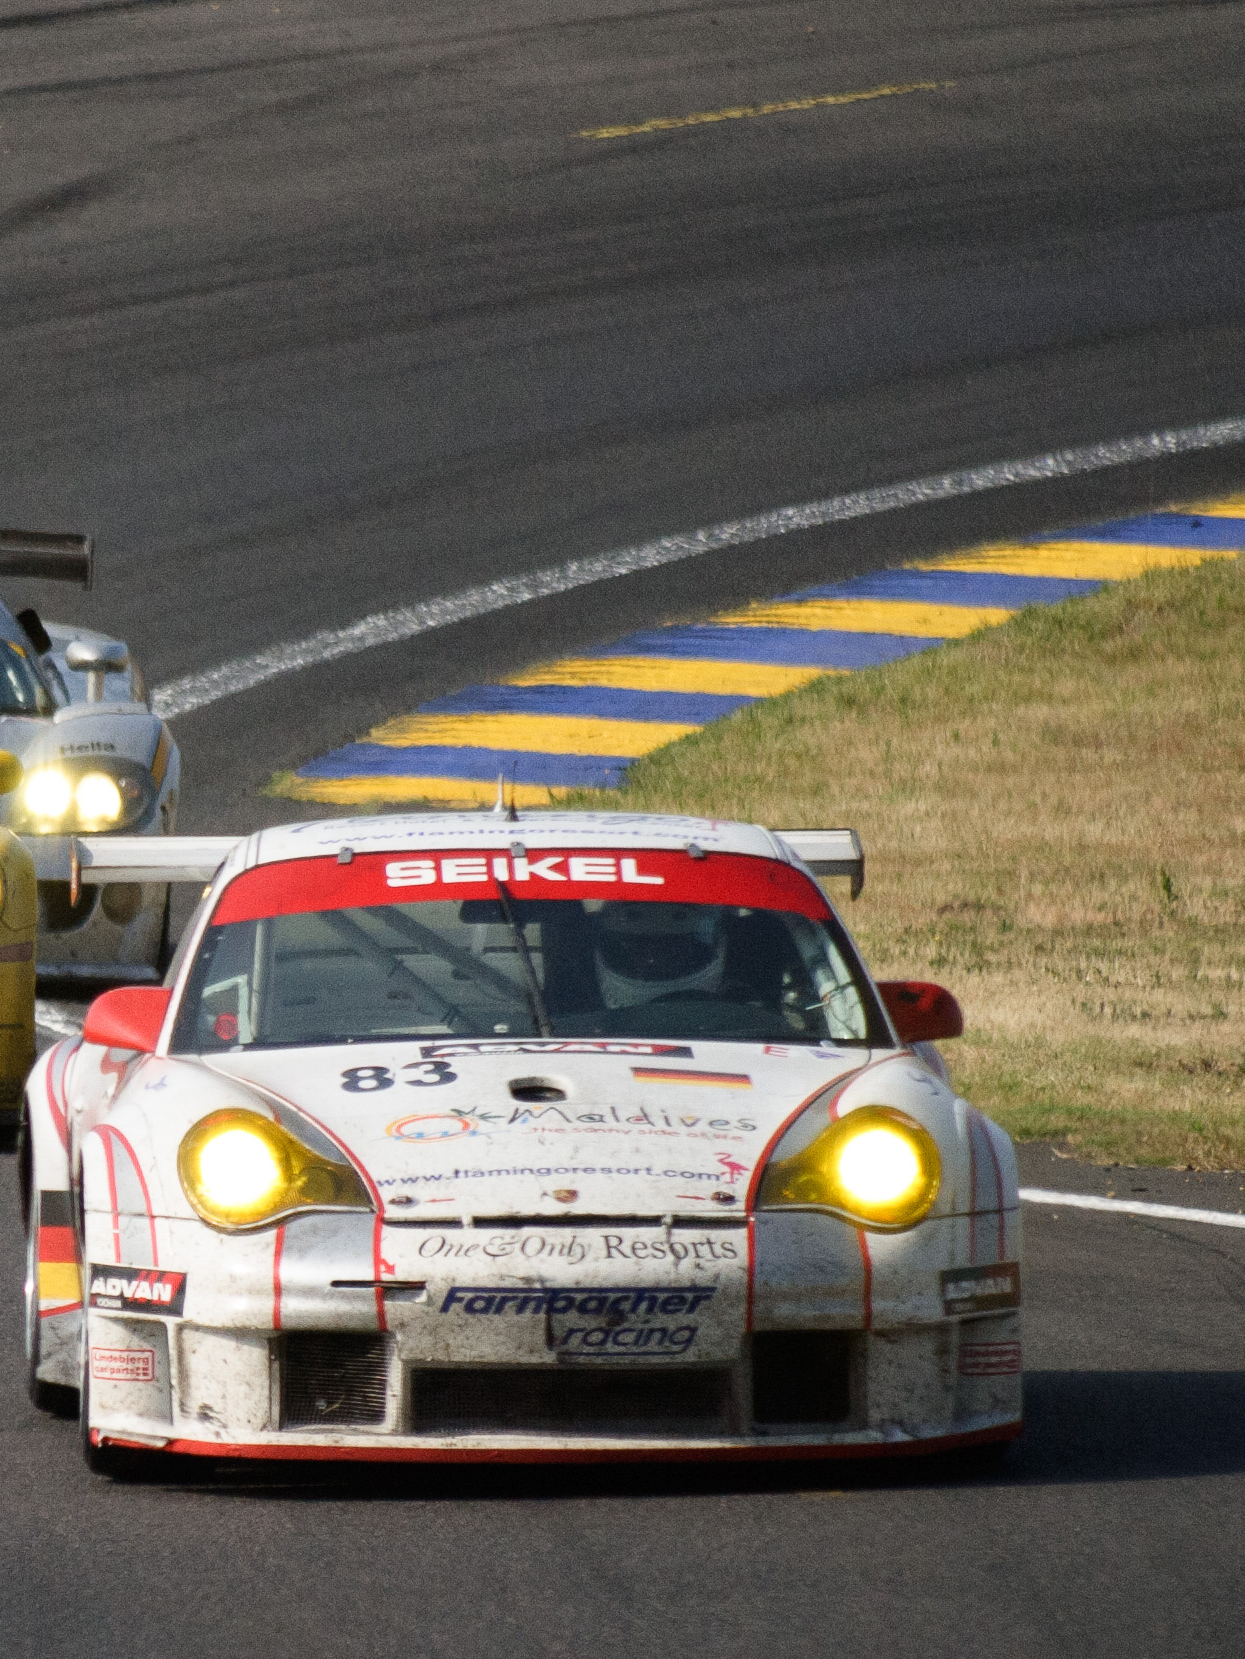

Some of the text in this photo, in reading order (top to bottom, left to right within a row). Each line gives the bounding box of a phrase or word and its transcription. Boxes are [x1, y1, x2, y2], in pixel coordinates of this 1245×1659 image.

[384, 856, 664, 887] SEIKEL
[339, 1060, 459, 1093] 83
[507, 1106, 758, 1132] Maldives
[376, 1166, 722, 1187] www.flamingoresort.com
[600, 1235, 739, 1260] Resorts
[89, 1276, 172, 1302] ADVAN
[439, 1286, 718, 1316] Farnbacher
[560, 1319, 698, 1352] racing
